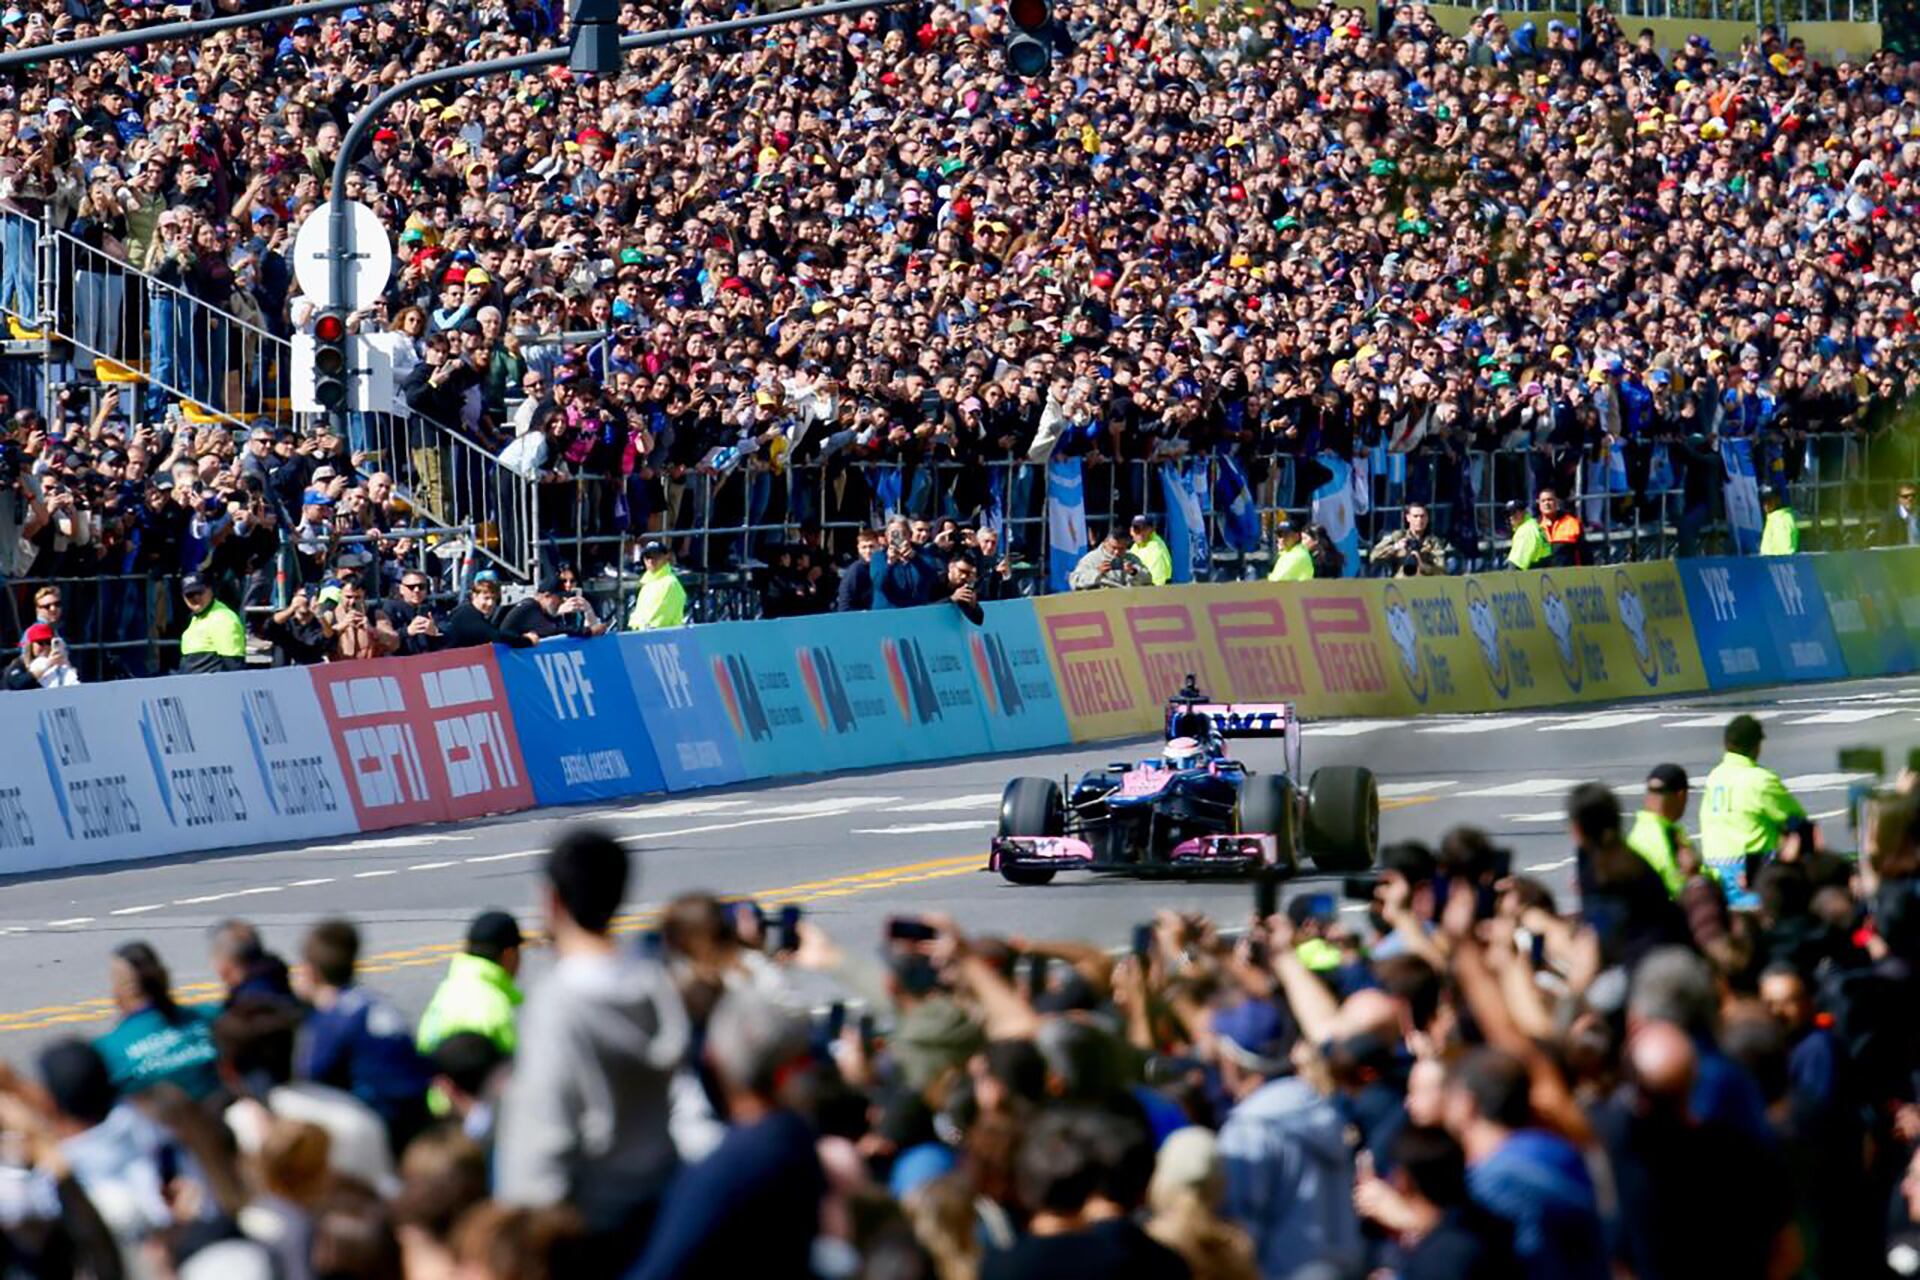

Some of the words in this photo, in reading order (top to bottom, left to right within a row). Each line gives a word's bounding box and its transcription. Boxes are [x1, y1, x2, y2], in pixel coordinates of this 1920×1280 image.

[1699, 567, 1737, 622] YPF
[1768, 563, 1805, 616] YPF
[534, 650, 596, 720] YPF
[645, 643, 693, 709] YPF
[1045, 610, 1135, 717] PIRELLI
[1208, 598, 1306, 697] PIRELLI
[1301, 597, 1388, 693] PIRELLI
[329, 676, 430, 808] ESPN
[420, 664, 519, 798] ESPN
[1213, 712, 1278, 730] WT
